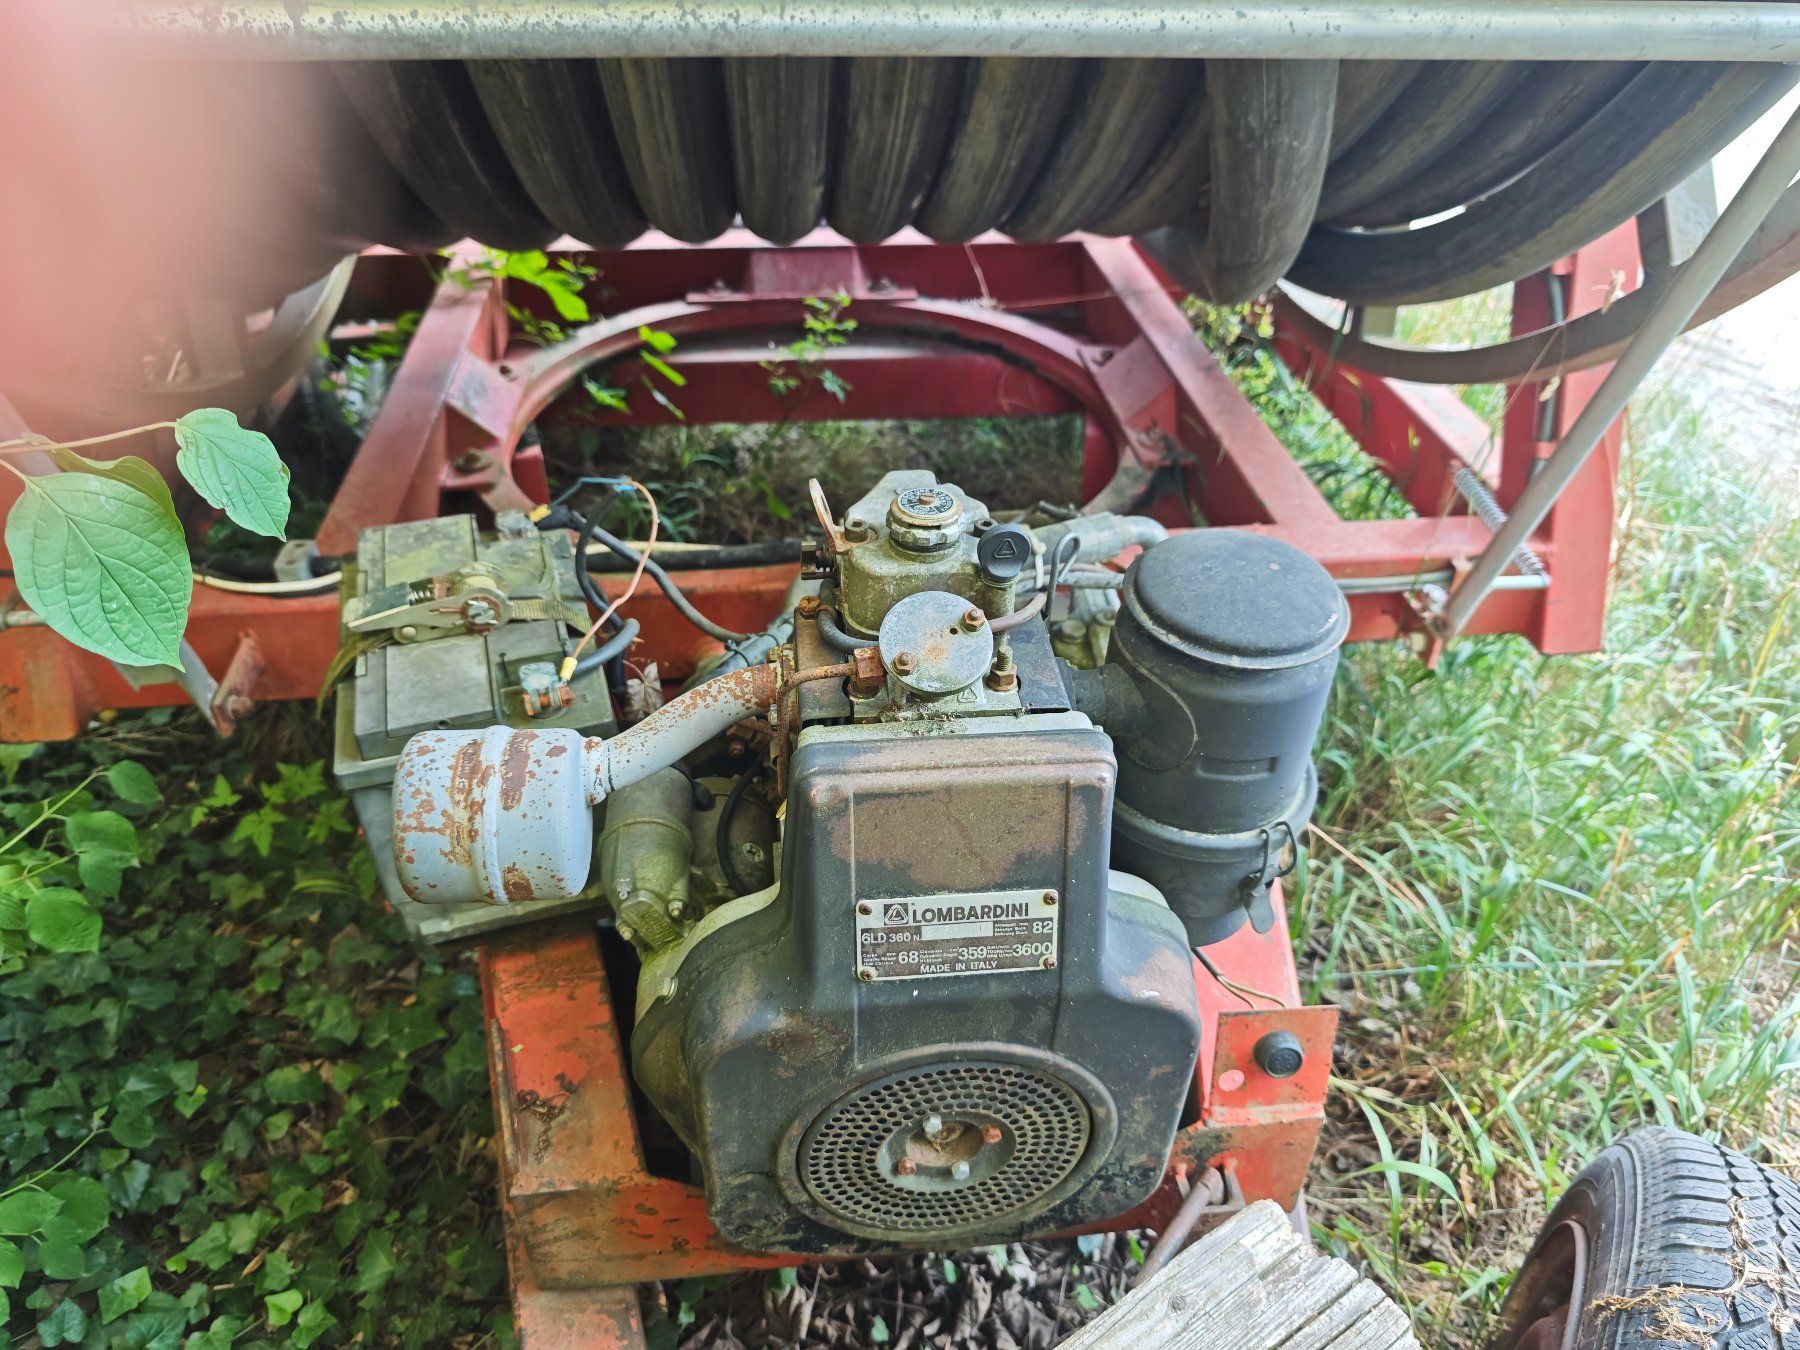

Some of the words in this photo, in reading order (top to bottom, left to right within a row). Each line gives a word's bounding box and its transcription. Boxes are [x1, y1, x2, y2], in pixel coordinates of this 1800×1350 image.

[912, 902, 1029, 924] LOMBARDINI
[1032, 920, 1053, 934] 82
[861, 933, 886, 944] 6LD
[889, 932, 910, 942] 360
[958, 945, 987, 960] 359
[1012, 941, 1052, 957] 3600
[898, 950, 919, 964] 68
[920, 963, 950, 974] MADE
[955, 962, 966, 971] IN
[970, 960, 998, 970] ITALY
